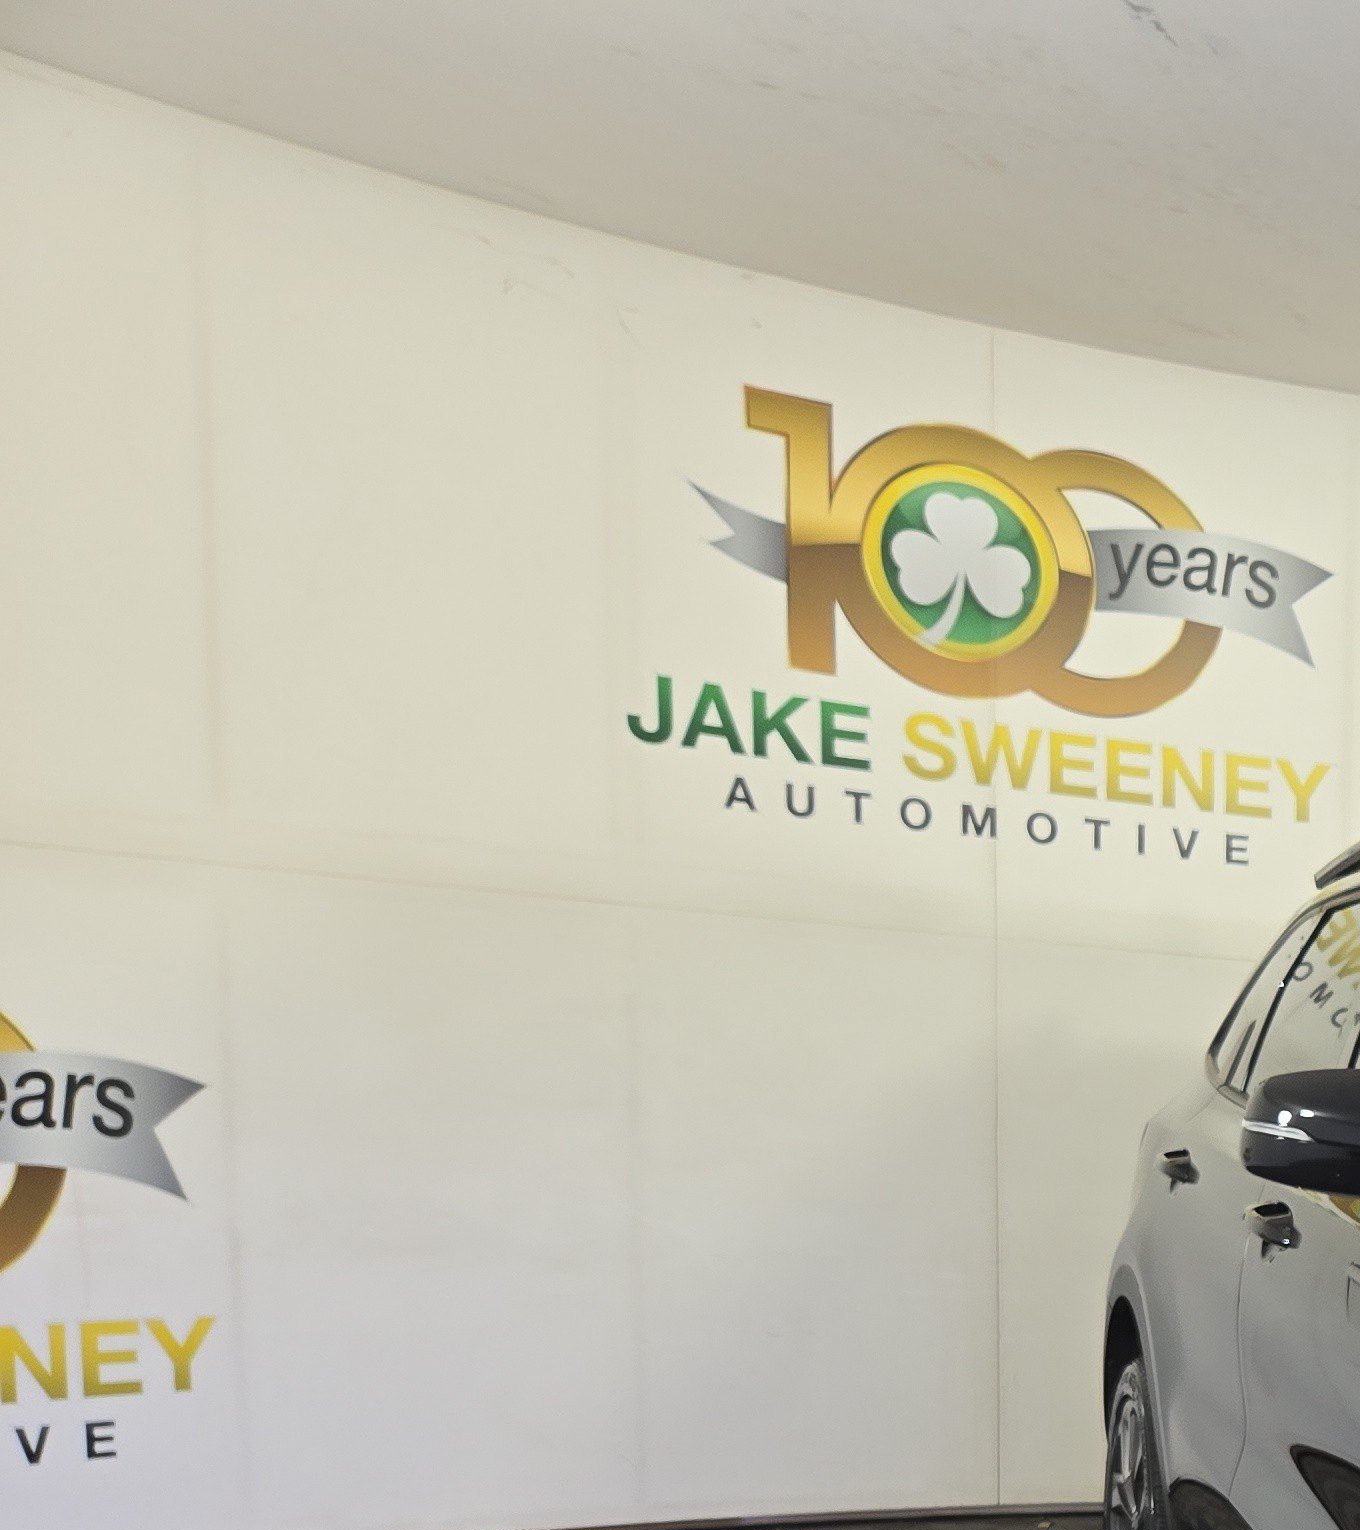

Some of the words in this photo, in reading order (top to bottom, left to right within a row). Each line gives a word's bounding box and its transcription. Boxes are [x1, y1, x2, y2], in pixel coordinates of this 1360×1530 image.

[1108, 537, 1279, 608] years
[627, 675, 871, 770] JAKE
[902, 712, 1330, 822] SWEENEY
[726, 777, 1250, 864] AUTOMOTIVE
[0, 1070, 135, 1137] ars
